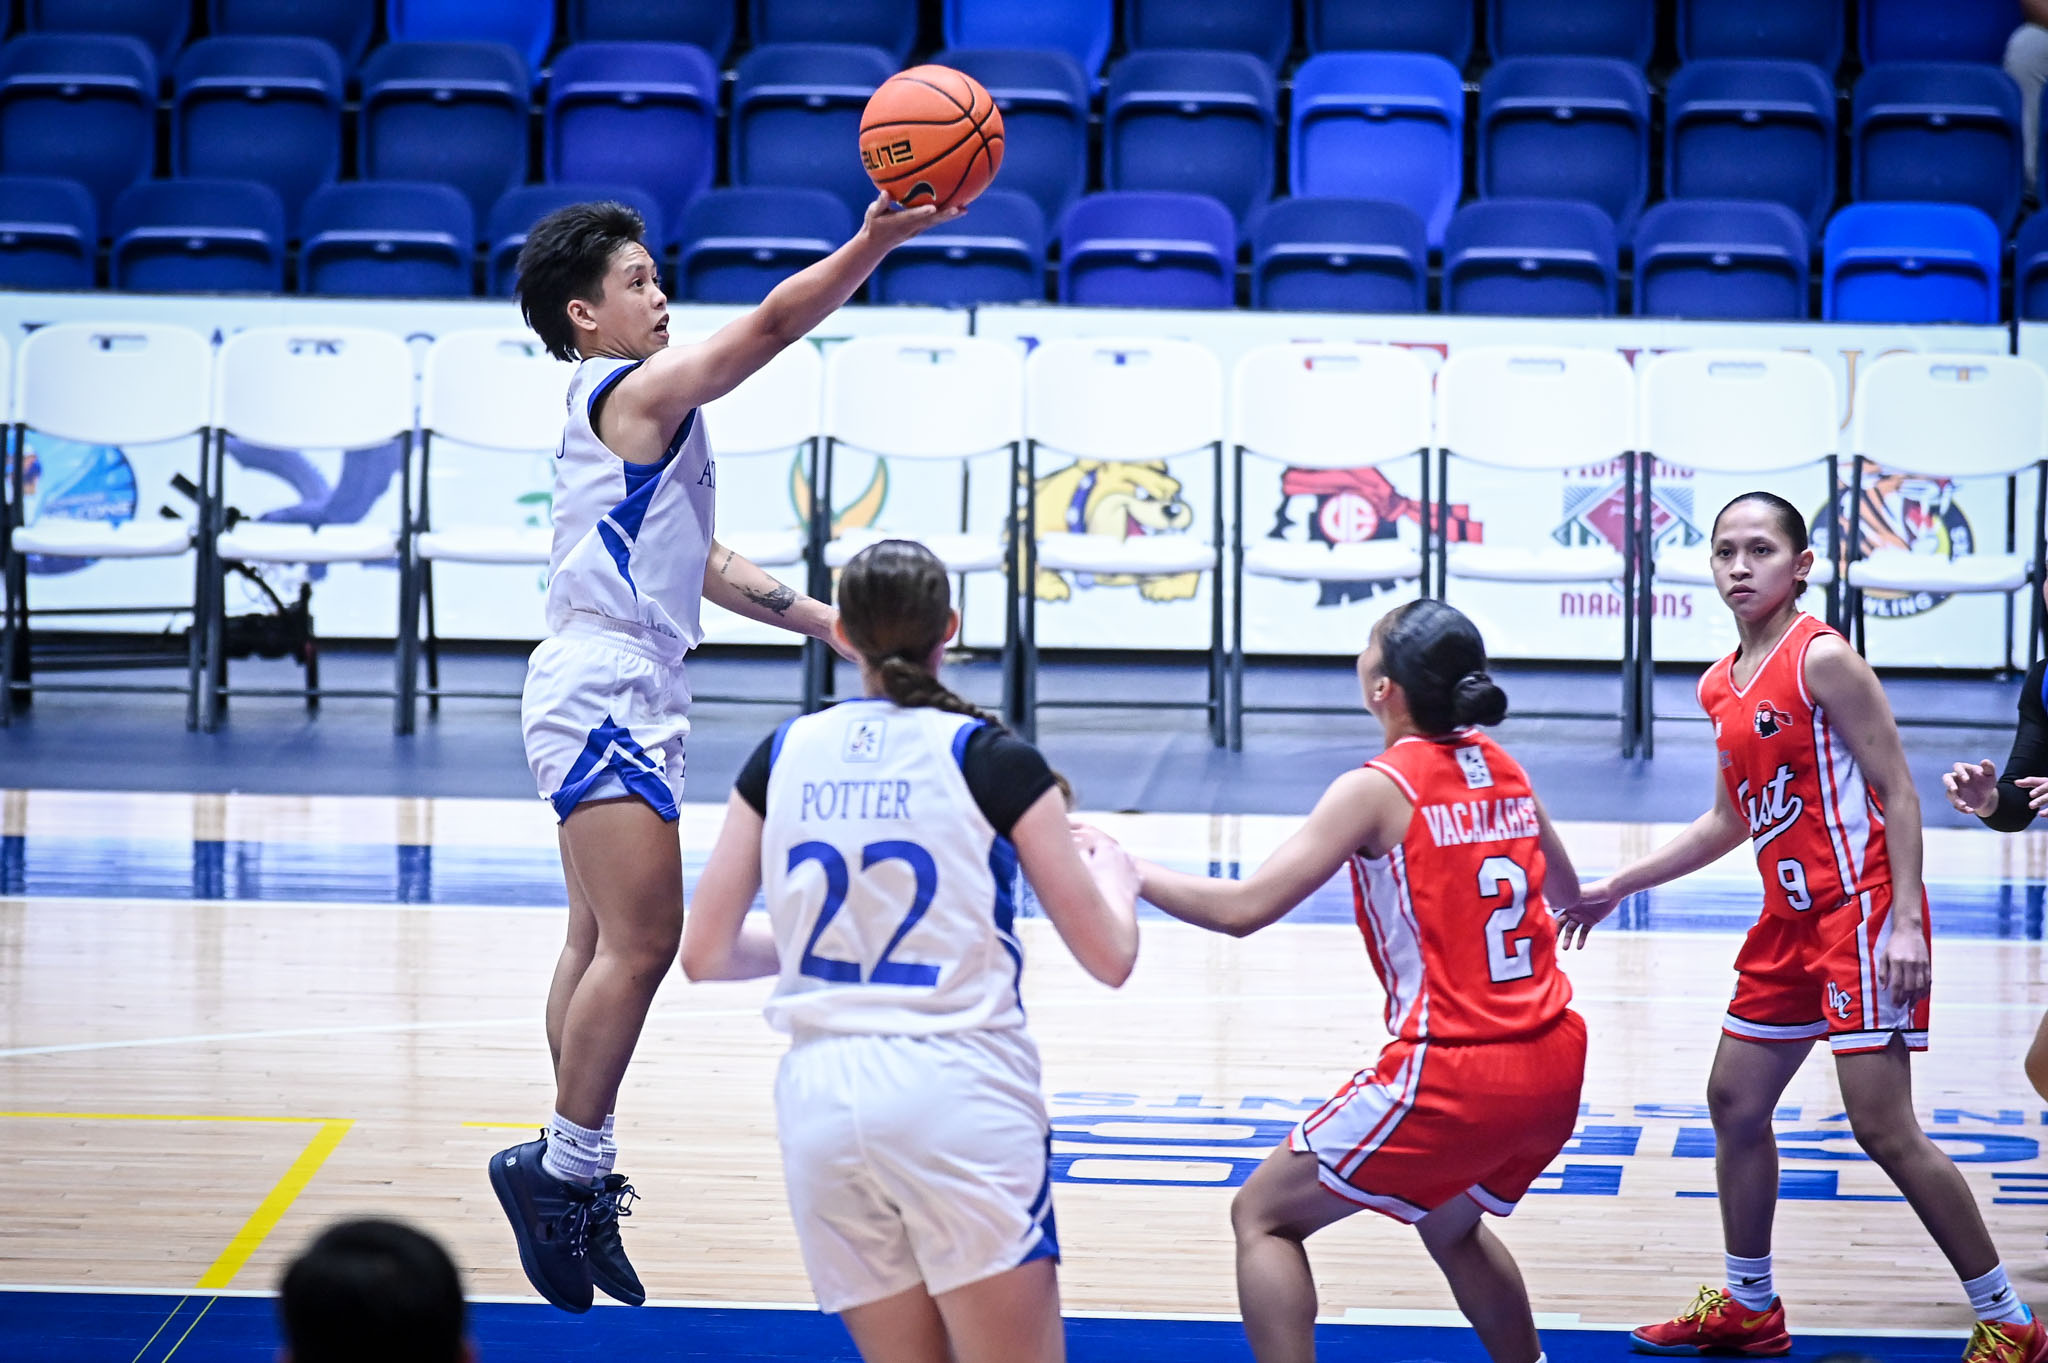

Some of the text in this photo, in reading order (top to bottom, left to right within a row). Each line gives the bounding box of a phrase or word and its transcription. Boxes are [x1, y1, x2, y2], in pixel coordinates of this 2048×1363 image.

[1560, 592, 1693, 618] MARNS
[801, 779, 912, 822] POTTER
[1776, 857, 1814, 912] 9
[787, 840, 941, 987] 22
[1477, 855, 1534, 984] 2
